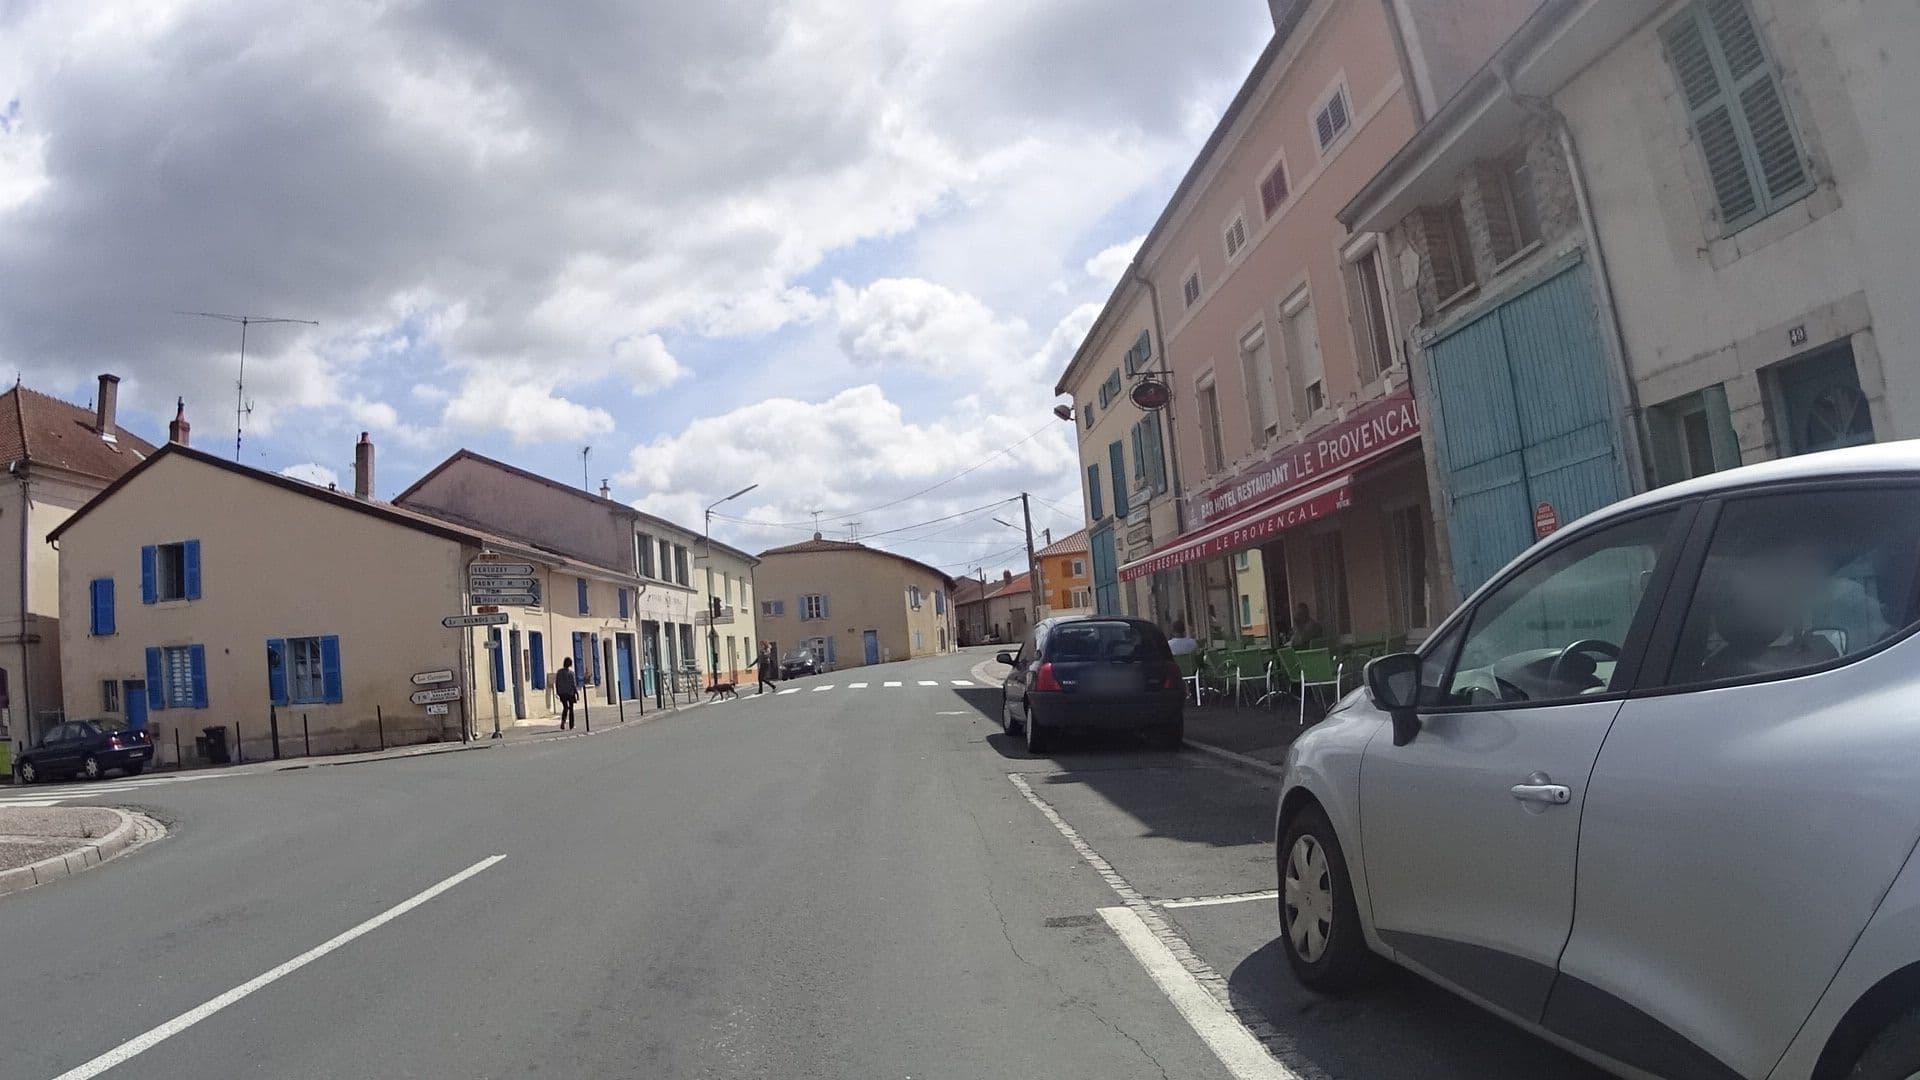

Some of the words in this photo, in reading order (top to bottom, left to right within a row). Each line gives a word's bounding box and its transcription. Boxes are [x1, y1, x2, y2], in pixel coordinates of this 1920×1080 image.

[1201, 500, 1215, 519] BAR
[1214, 490, 1237, 513] HOTEL
[1237, 463, 1289, 503] RESTAURANT
[1294, 453, 1315, 479] LE
[1317, 399, 1420, 469] PROVENCAL
[1157, 543, 1207, 571] RESTAURANT
[1216, 536, 1229, 551] LE
[1234, 503, 1319, 545] PROVENCAL
